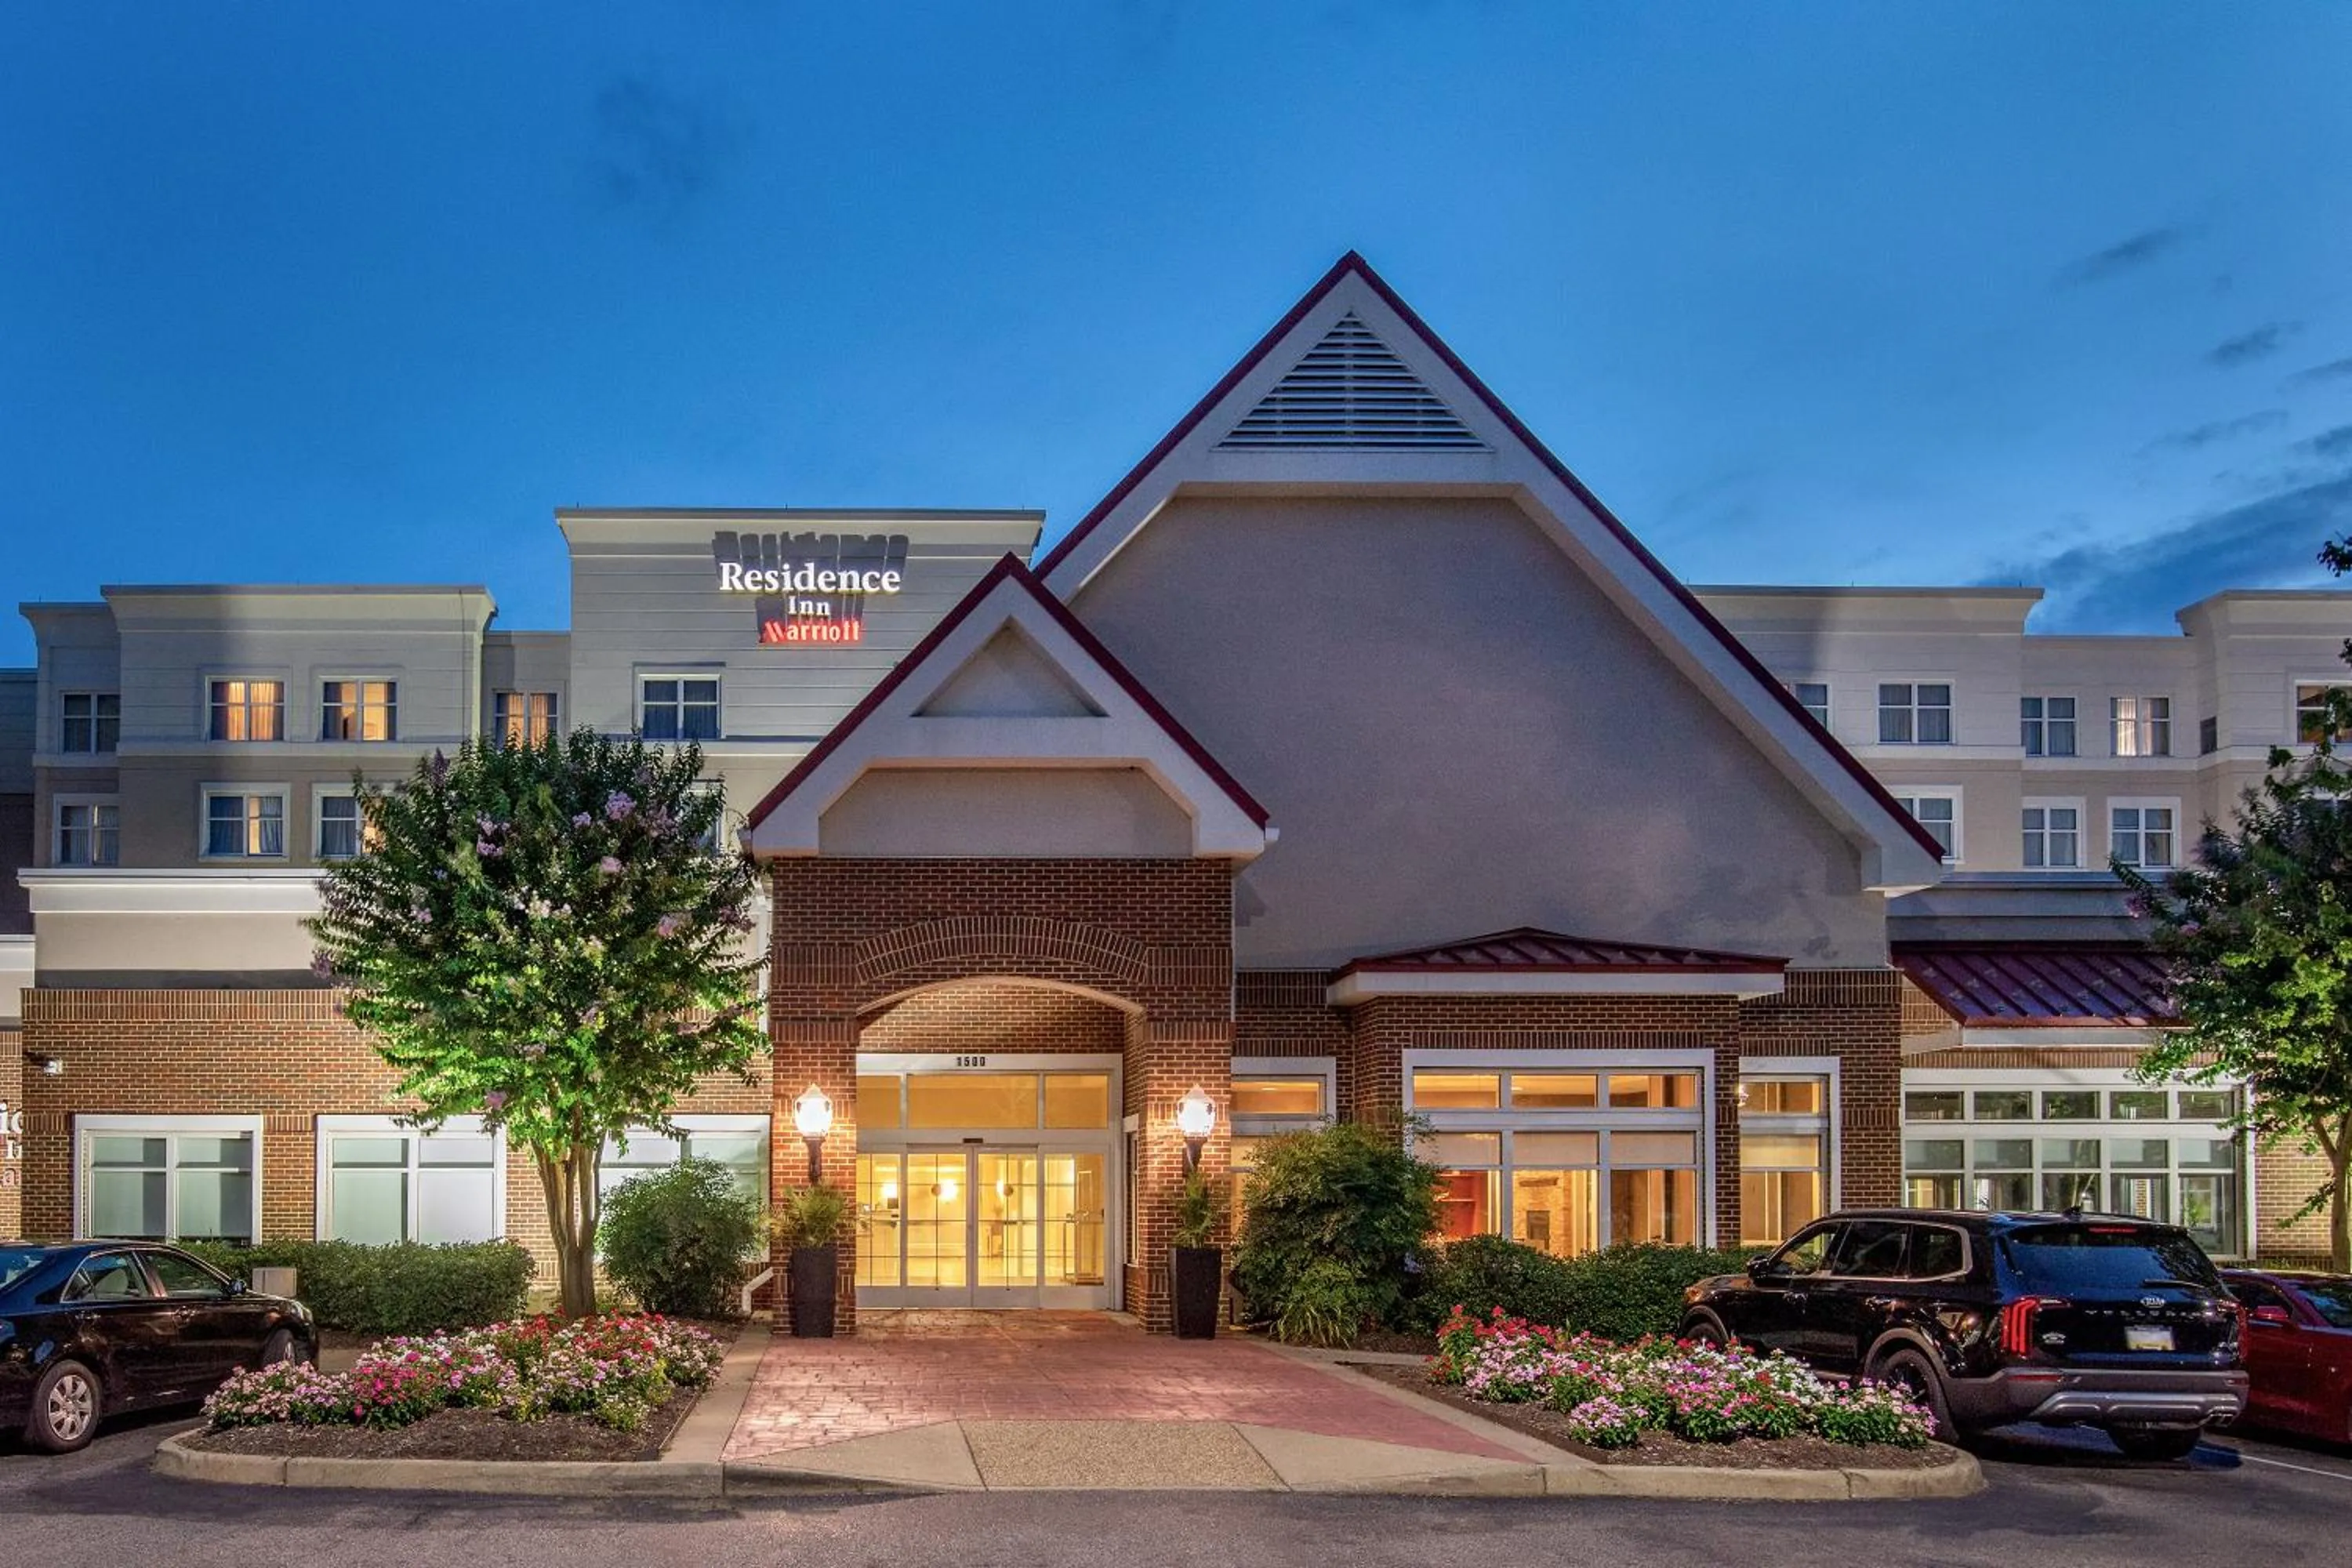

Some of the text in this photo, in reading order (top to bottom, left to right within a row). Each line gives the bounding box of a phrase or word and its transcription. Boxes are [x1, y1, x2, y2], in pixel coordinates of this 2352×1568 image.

[719, 561, 901, 592] Residence
[787, 595, 831, 615] Inn
[764, 620, 859, 643] Marriott
[956, 1056, 985, 1067] 1500
